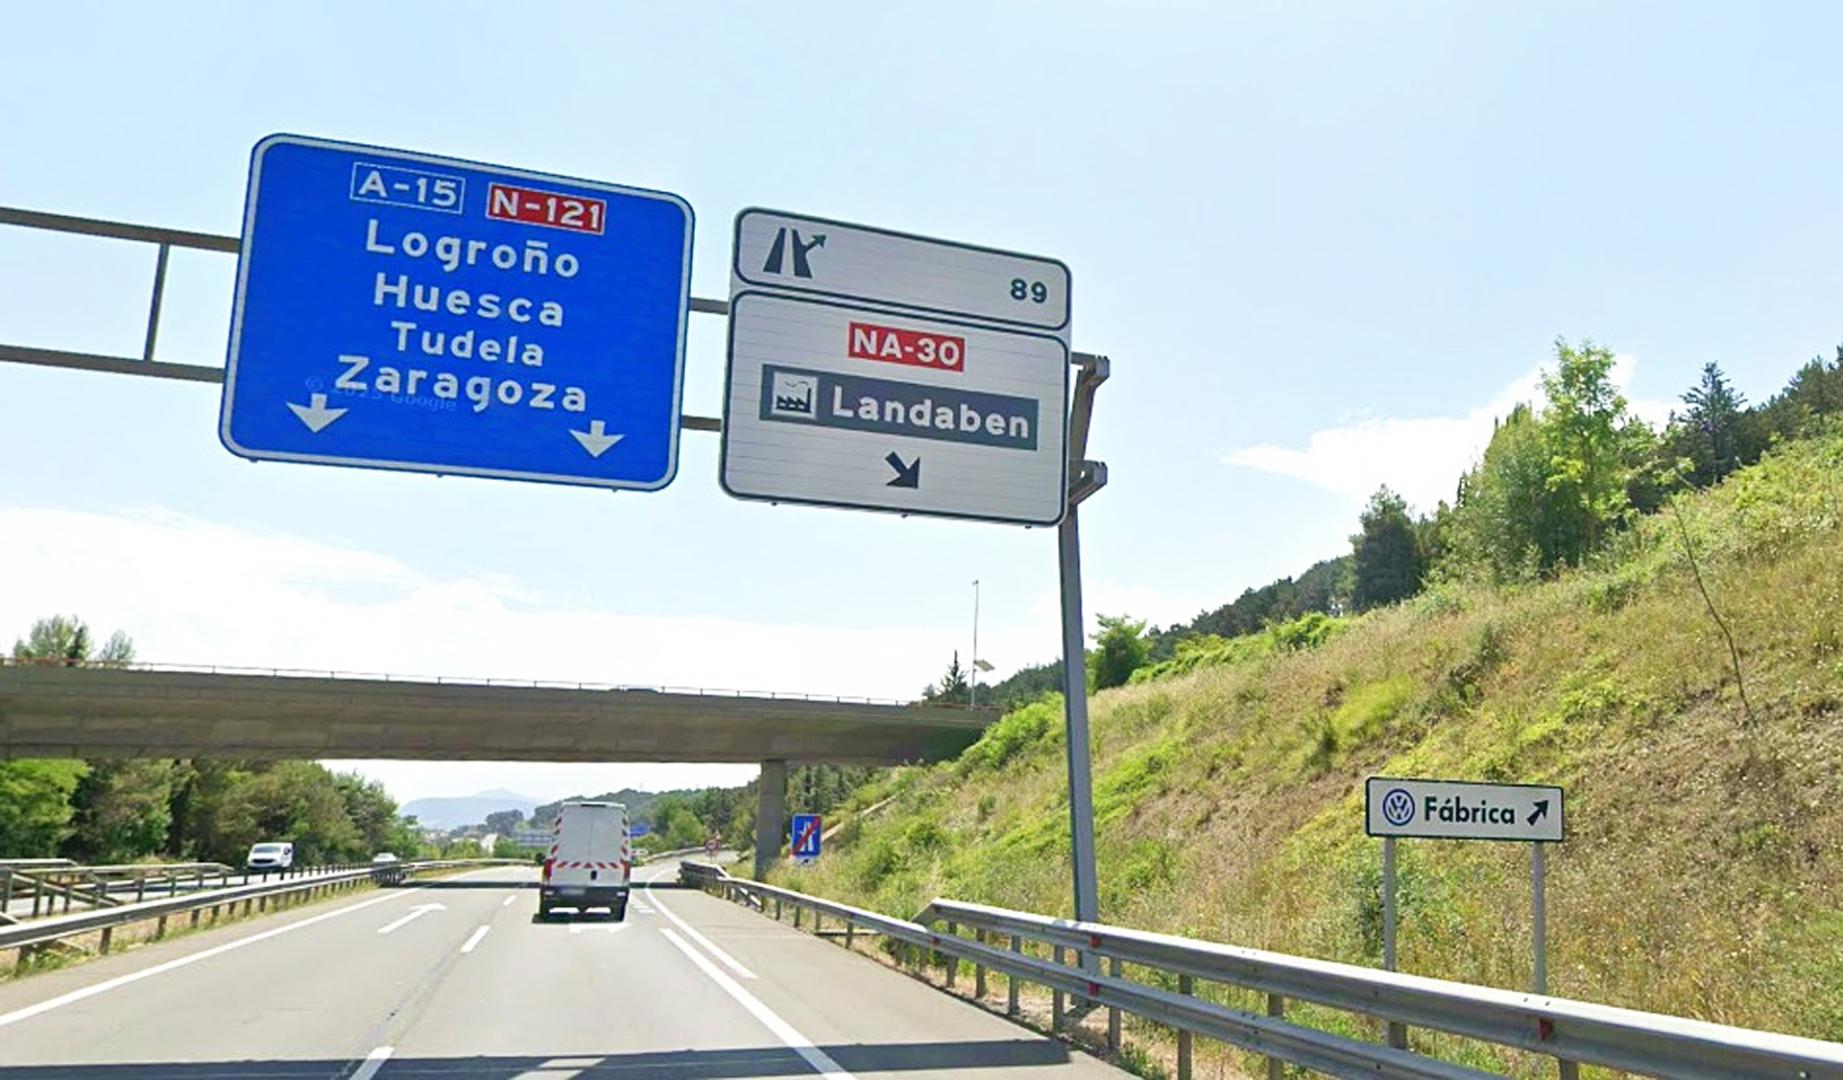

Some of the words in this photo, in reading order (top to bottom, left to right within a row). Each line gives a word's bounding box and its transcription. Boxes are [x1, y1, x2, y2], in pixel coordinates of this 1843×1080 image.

[358, 170, 456, 206] A-15
[493, 189, 601, 230] N-121
[366, 219, 579, 277] Logroño
[374, 272, 563, 327] Huesca
[1010, 278, 1048, 304] 89
[391, 321, 544, 367] Tudela
[853, 328, 961, 367] NA-30
[338, 355, 587, 412] Zaragoza
[833, 386, 1029, 438] Landaben
[1424, 795, 1516, 825] Fábrica
